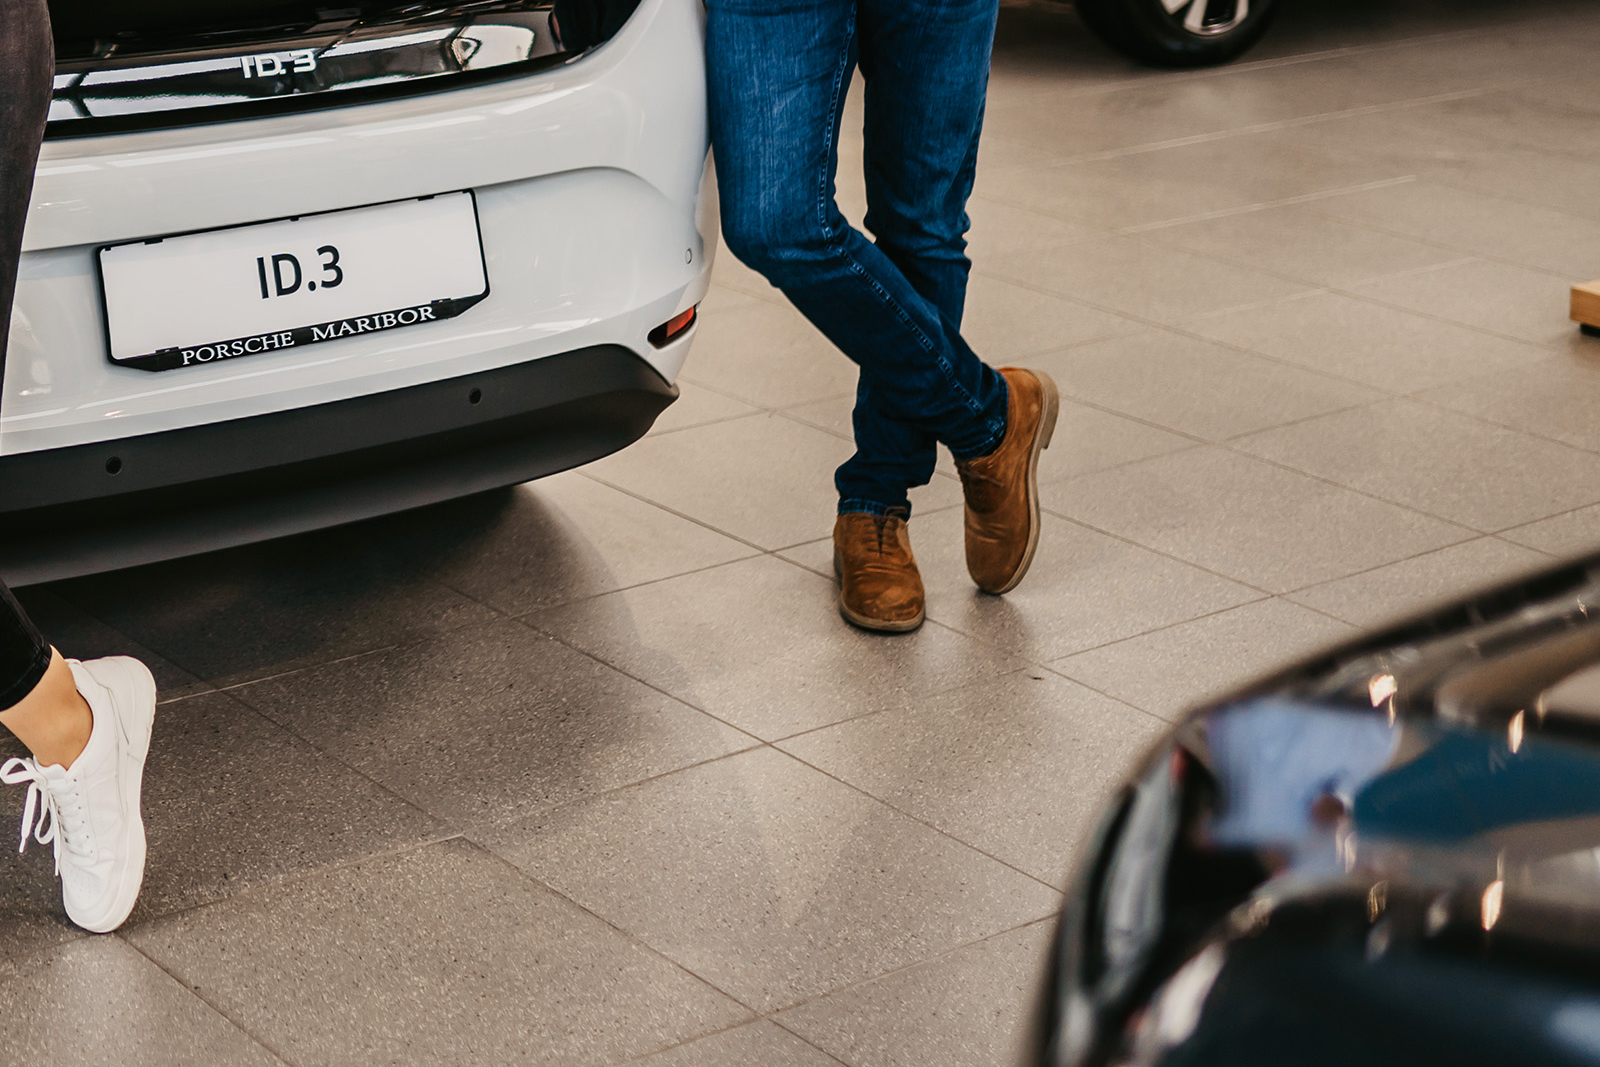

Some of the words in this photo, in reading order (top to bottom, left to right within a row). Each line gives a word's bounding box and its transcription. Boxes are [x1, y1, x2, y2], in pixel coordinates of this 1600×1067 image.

[240, 50, 317, 79] ID.3
[256, 244, 344, 299] ID.3
[181, 331, 295, 367] PORSCHE
[311, 305, 437, 342] MARIBOR
